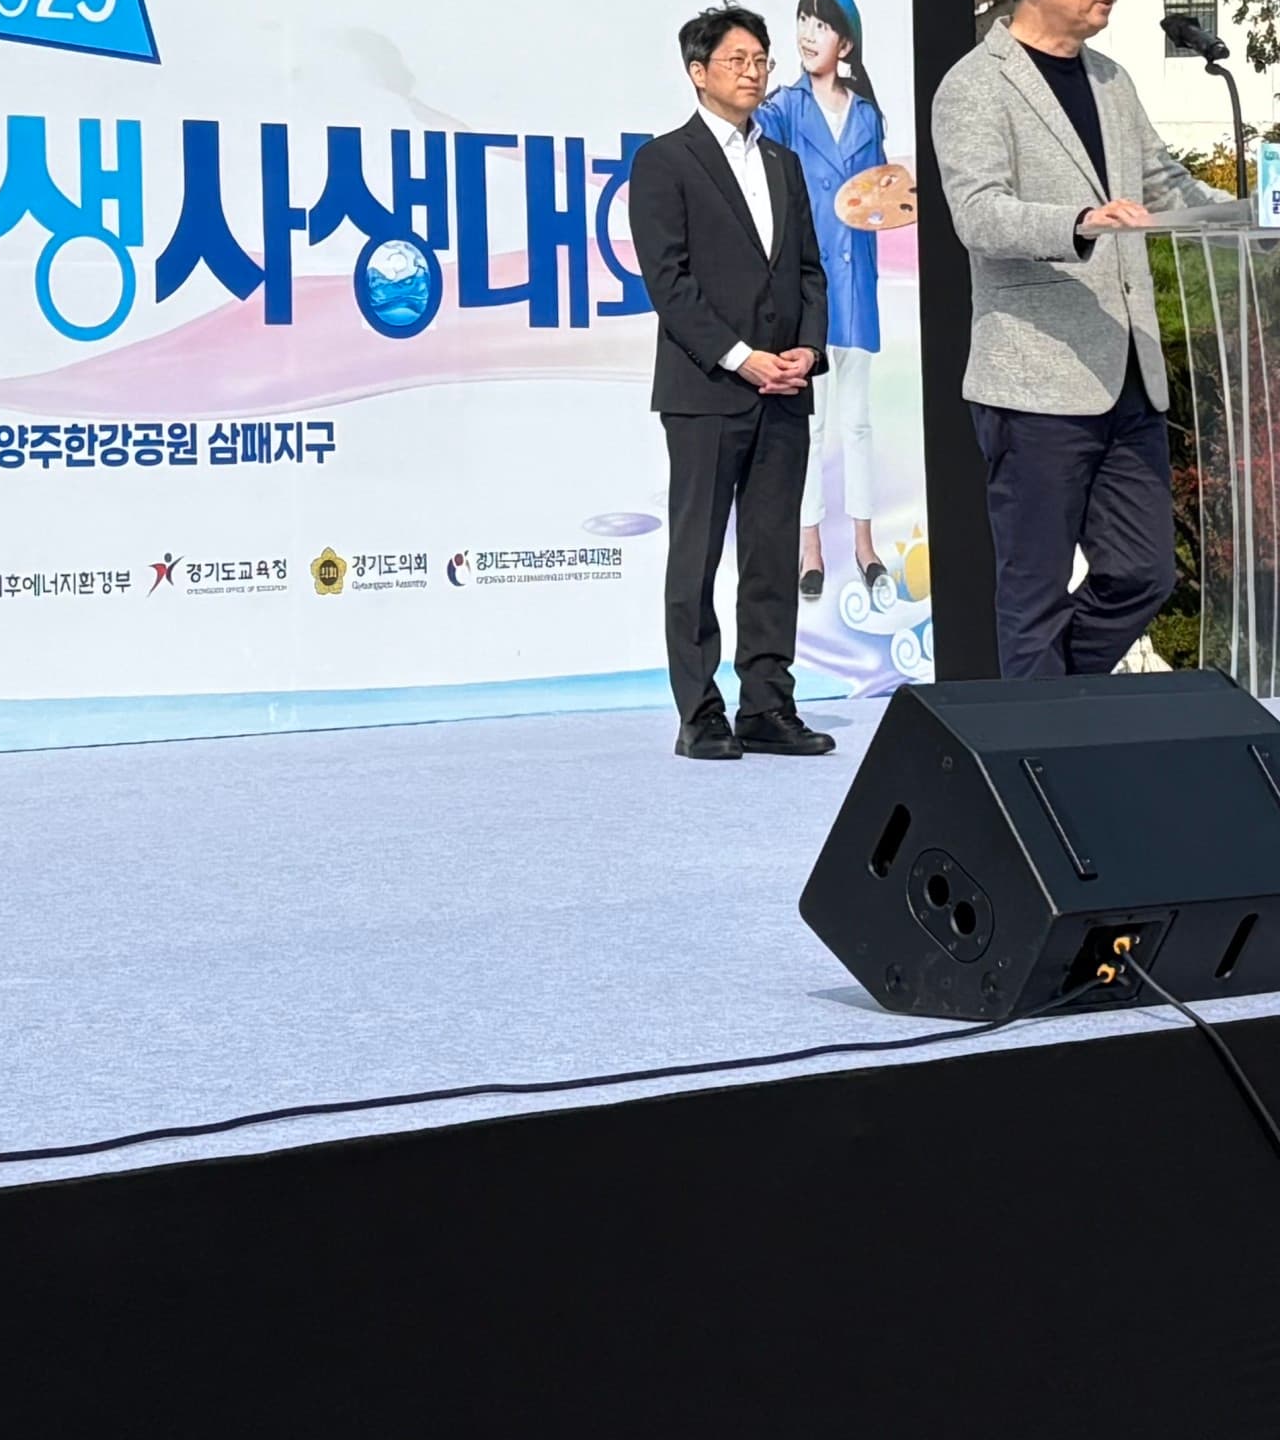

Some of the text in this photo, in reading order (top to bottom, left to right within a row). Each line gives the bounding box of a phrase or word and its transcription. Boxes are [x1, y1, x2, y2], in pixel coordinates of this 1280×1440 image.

[208, 420, 336, 465] 삼패지구
[186, 558, 288, 583] 경기도교육청
[352, 552, 428, 577] 경기도의회
